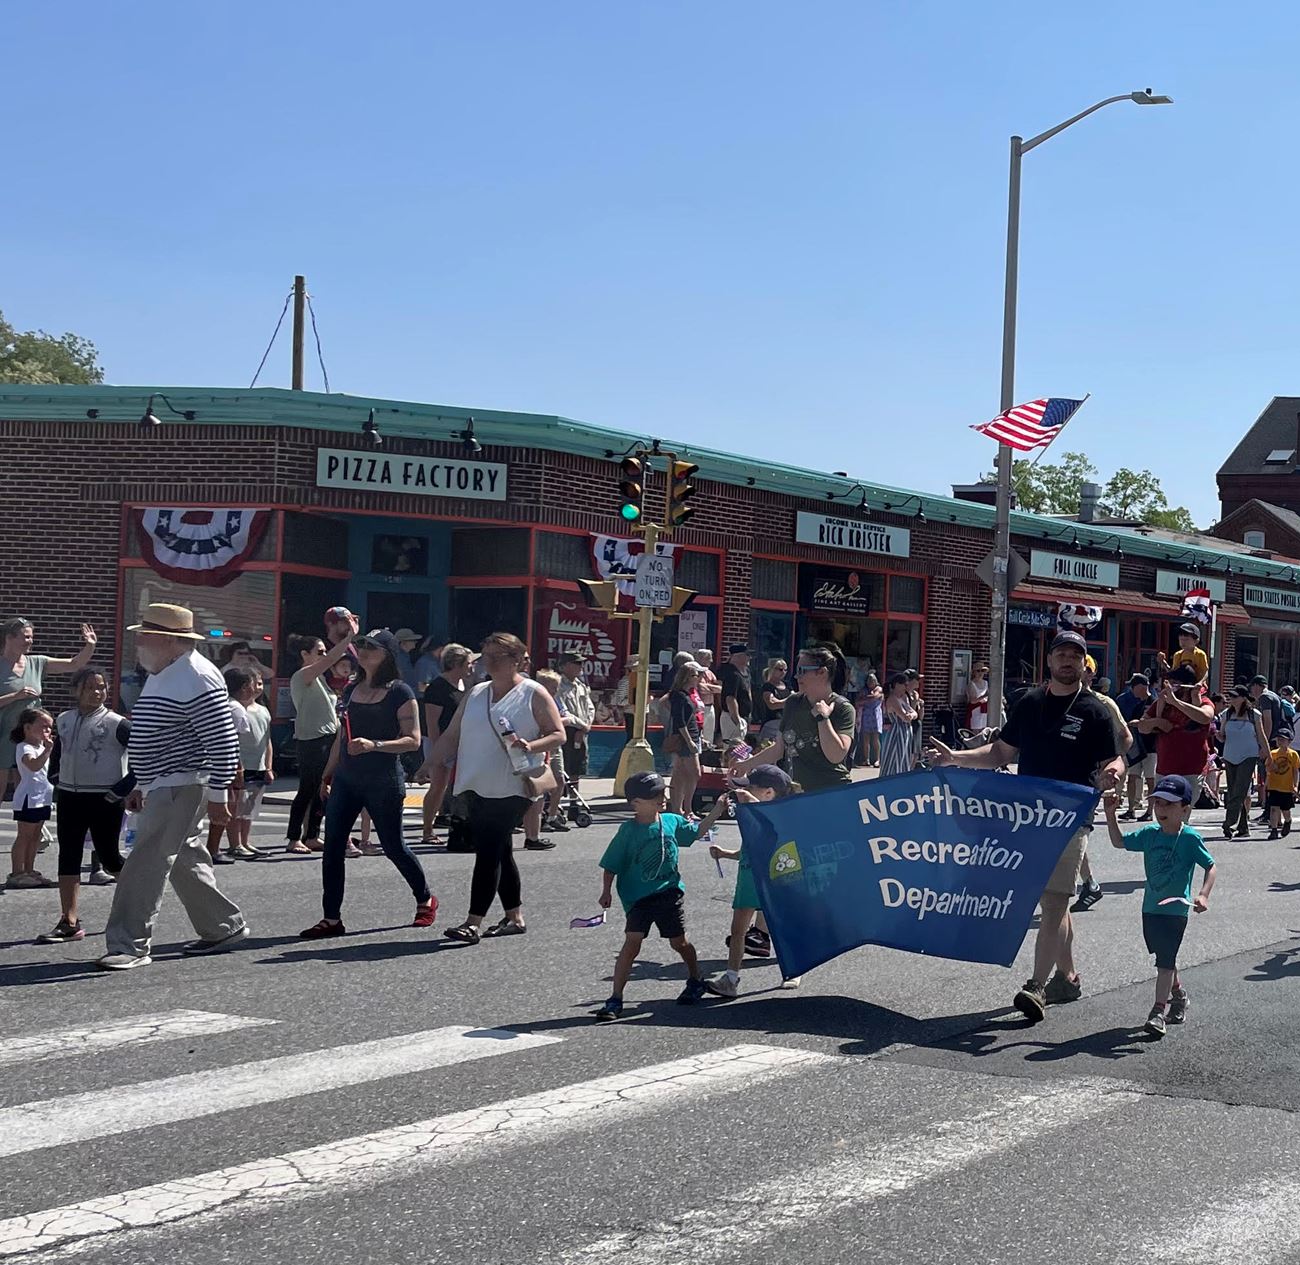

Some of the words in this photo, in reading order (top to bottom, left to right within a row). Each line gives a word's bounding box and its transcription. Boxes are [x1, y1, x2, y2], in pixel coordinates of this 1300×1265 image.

[327, 455, 392, 484] PIZZA
[402, 462, 499, 492] FACTORY
[825, 517, 848, 527] INCOME
[850, 521, 861, 529] TAX
[863, 523, 886, 533] SERVICE
[819, 523, 844, 546] RICK
[848, 528, 891, 553] KRISTEK
[649, 561, 663, 572] NO
[1054, 558, 1071, 576] FULL
[1074, 560, 1098, 580] CIRCLE
[644, 575, 666, 587] TURN
[639, 591, 650, 600] ON
[654, 591, 670, 601] RED
[1246, 588, 1263, 602] UNITED
[1264, 589, 1279, 605] STATES
[1280, 592, 1297, 608] POSTAL
[681, 612, 696, 621] BUY
[1009, 609, 1018, 623] Full
[1018, 610, 1031, 624] Circle
[693, 622, 705, 631] ONE
[680, 631, 694, 640] GET
[547, 638, 594, 655] PIZZA
[691, 641, 705, 649] ONE
[547, 657, 613, 677] FORY
[858, 784, 1077, 833] Northampton
[868, 835, 1024, 871] Recreation
[878, 878, 1014, 920] Department
